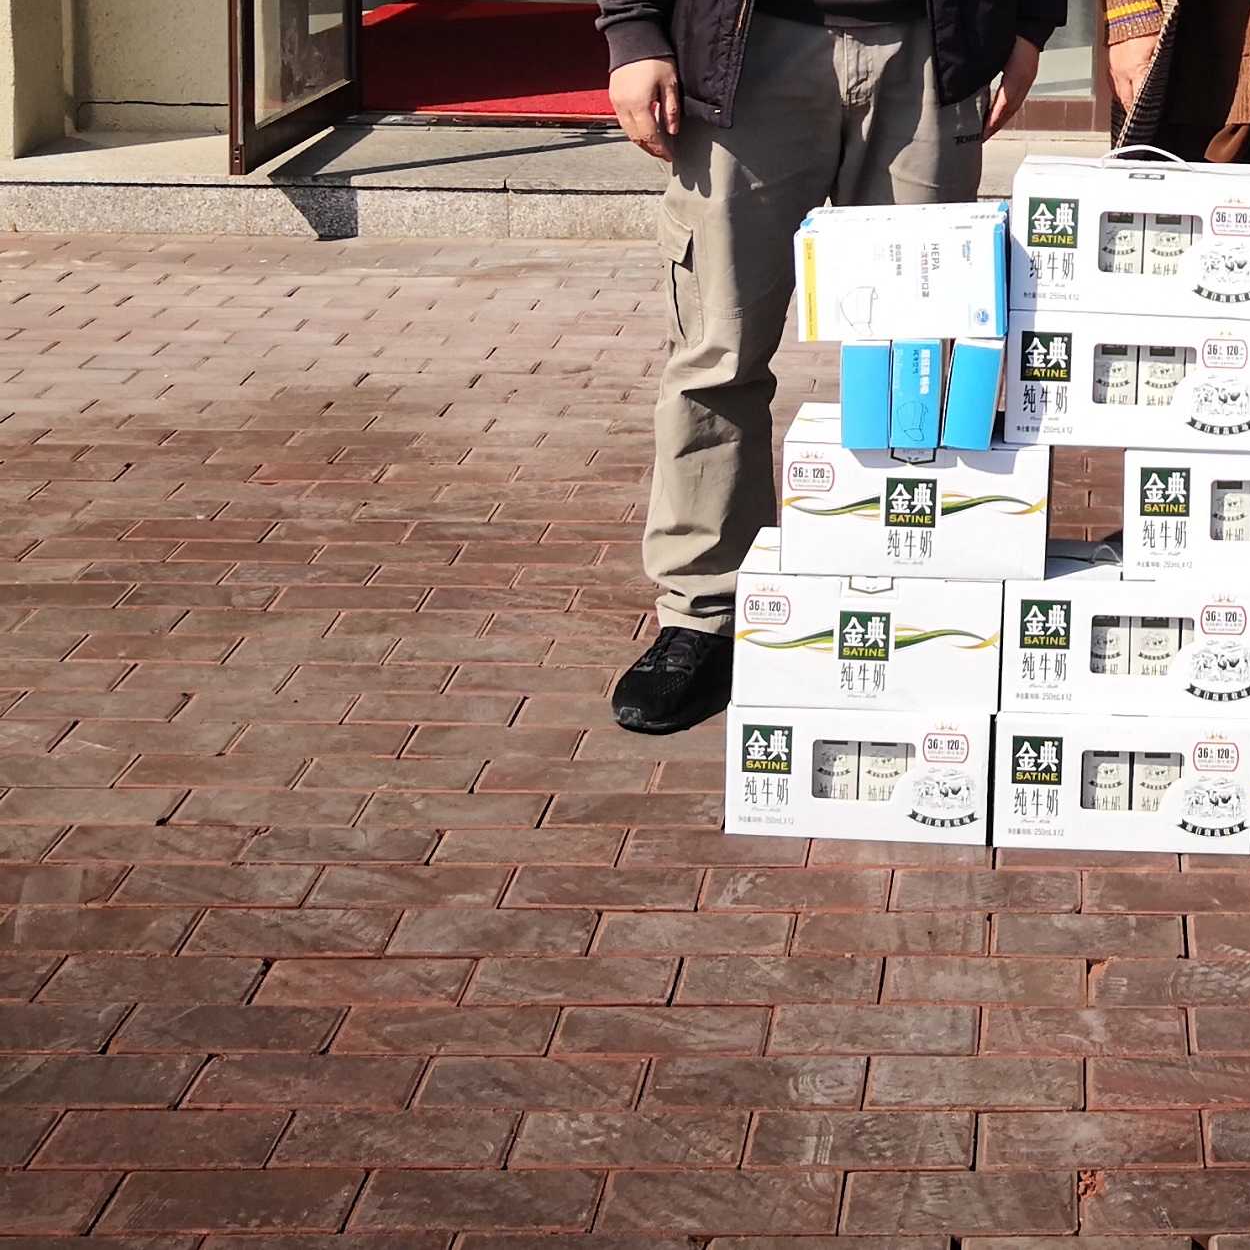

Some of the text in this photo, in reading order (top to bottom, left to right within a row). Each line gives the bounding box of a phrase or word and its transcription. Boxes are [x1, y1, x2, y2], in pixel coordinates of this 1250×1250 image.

[1031, 203, 1075, 234] 金典
[1234, 211, 1247, 224] 120
[1032, 235, 1074, 245] SATINE
[931, 243, 940, 271] HEPA
[1030, 251, 1074, 281] 纯牛奶
[1025, 337, 1068, 368] 金典
[1226, 345, 1239, 356] 120
[1025, 368, 1067, 378] SATINE
[1023, 384, 1068, 415] 纯牛奶
[812, 467, 825, 479] 120
[889, 482, 933, 514] 金典
[1143, 471, 1187, 504] 金典
[889, 514, 932, 524] SATINE
[1144, 504, 1186, 513] SATINE
[887, 529, 932, 558] 纯牛奶
[1142, 520, 1187, 549] 纯牛奶
[768, 601, 781, 612] 120
[1024, 605, 1067, 636] 金典
[1225, 611, 1237, 623] 120
[843, 616, 886, 648] 金典
[1024, 636, 1066, 646] SATINE
[842, 647, 885, 657] SATINE
[840, 662, 886, 692] 纯牛奶
[1022, 652, 1067, 682] 纯牛奶
[745, 729, 789, 761] 金典
[947, 739, 960, 751] 120
[1015, 741, 1059, 772] 金典
[1216, 748, 1229, 760] 120
[746, 760, 788, 771] SATINE
[1015, 771, 1058, 781] SATINE
[744, 776, 789, 806] 纯牛奶
[1014, 787, 1059, 817] 纯牛奶
